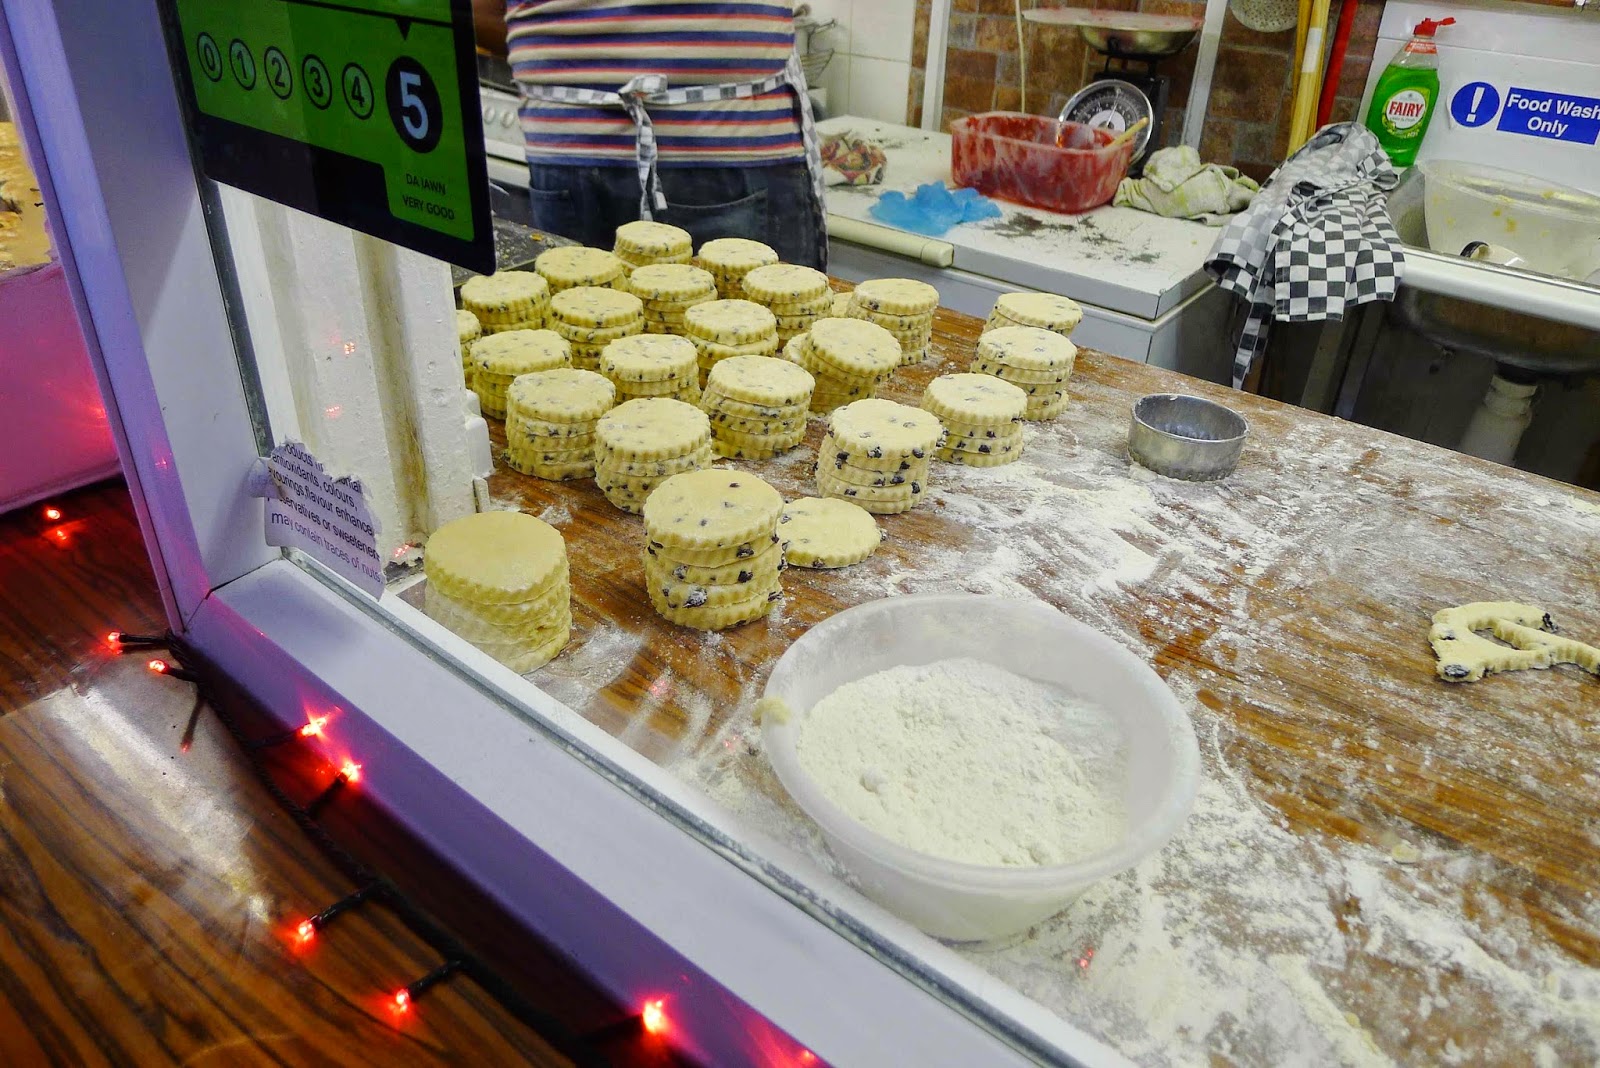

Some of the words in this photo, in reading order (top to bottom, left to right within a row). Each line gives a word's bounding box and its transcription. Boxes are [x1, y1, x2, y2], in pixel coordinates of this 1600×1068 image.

[204, 43, 215, 71] 0
[237, 50, 247, 79] 1
[272, 57, 285, 87] 2
[310, 66, 323, 98] 3
[351, 76, 365, 107] 4
[400, 71, 428, 139] 5
[1389, 101, 1424, 117] FAIRY
[1507, 93, 1552, 113] Food
[1556, 100, 1600, 120] Wash
[1527, 116, 1569, 137] Only
[406, 173, 420, 187] DA
[420, 177, 446, 196] IAWN
[402, 194, 424, 211] VERY
[426, 202, 455, 220] GOOD
[285, 443, 313, 467] oducts
[322, 518, 331, 531] or
[335, 506, 374, 536] enhance
[271, 512, 293, 531] may
[294, 521, 323, 546] contain
[323, 537, 350, 564] traces
